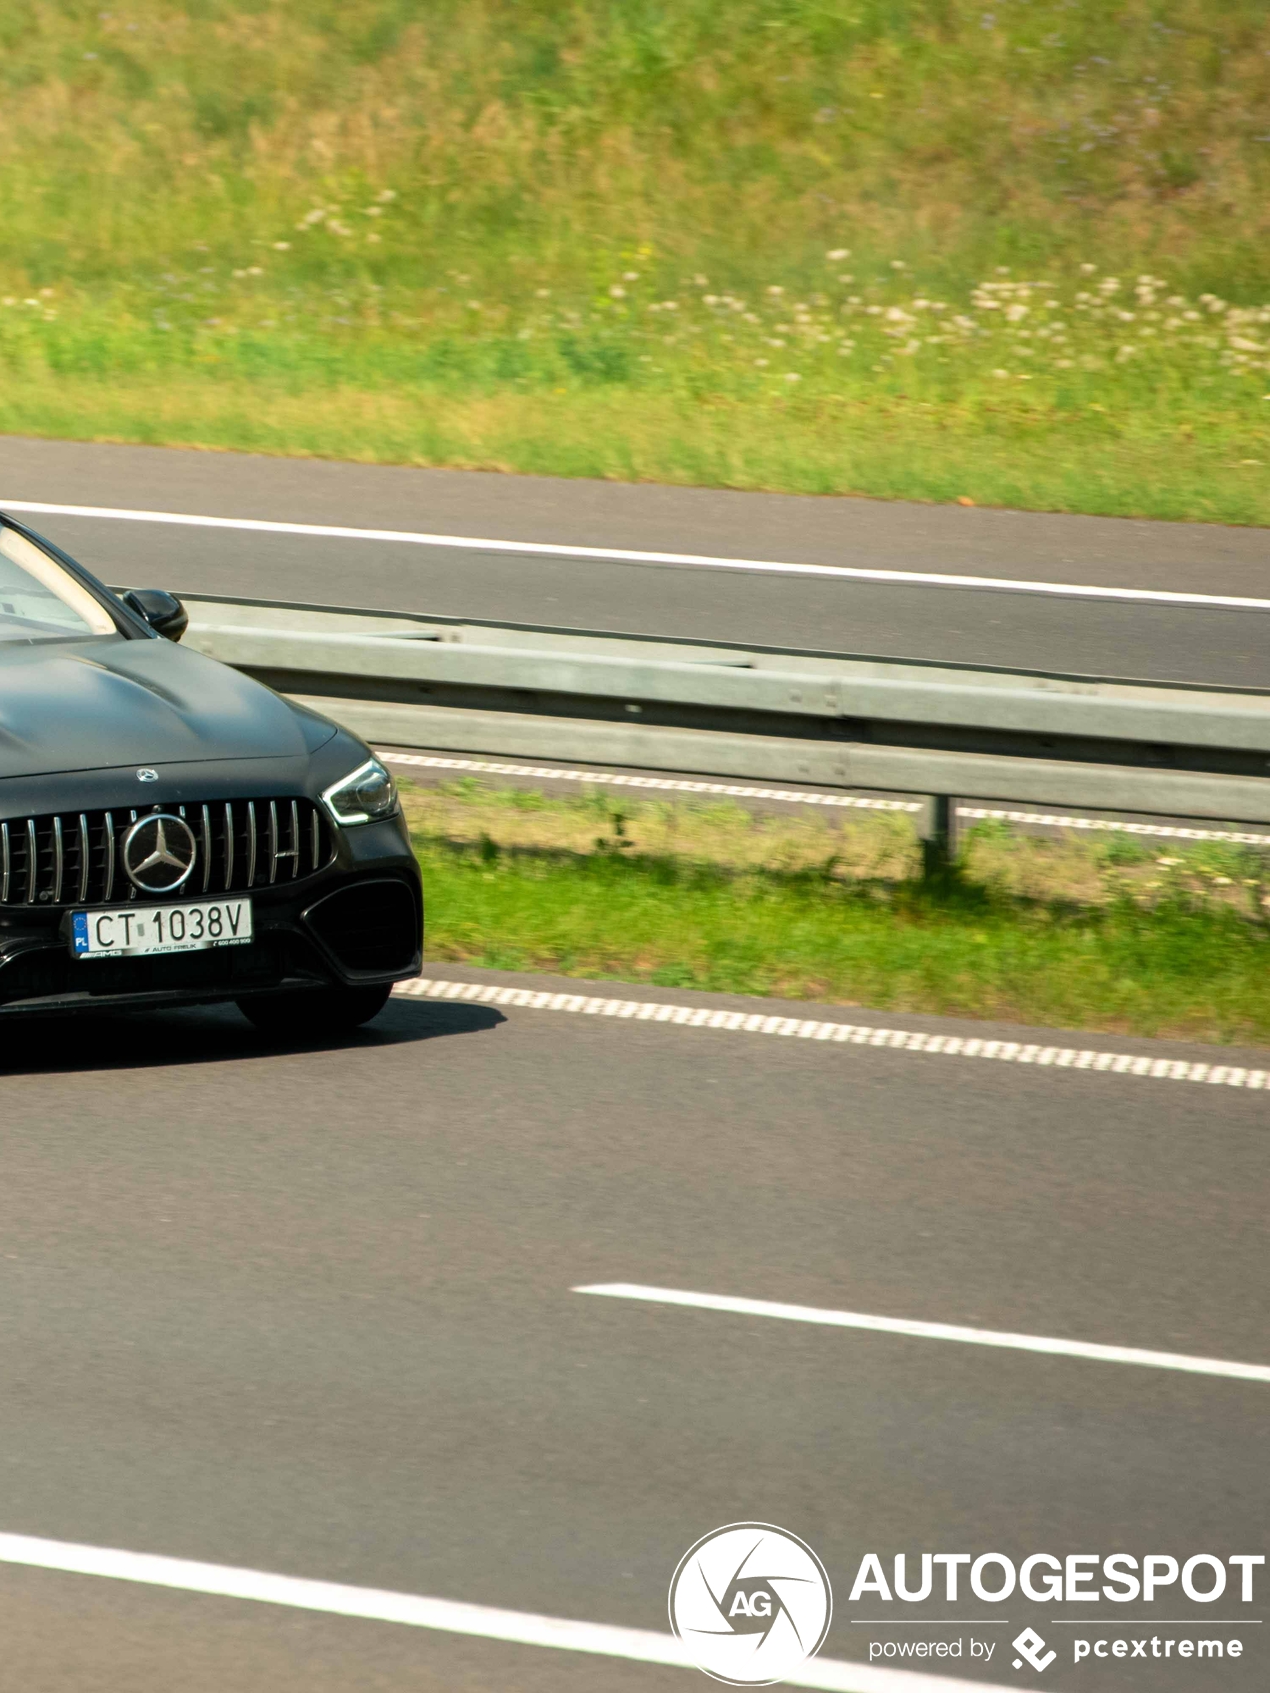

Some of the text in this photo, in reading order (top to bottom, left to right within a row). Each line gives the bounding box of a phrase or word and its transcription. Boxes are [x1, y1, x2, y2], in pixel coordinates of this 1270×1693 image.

[95, 903, 242, 947] CT 1038V
[75, 937, 88, 947] PL
[93, 949, 122, 958] AMG
